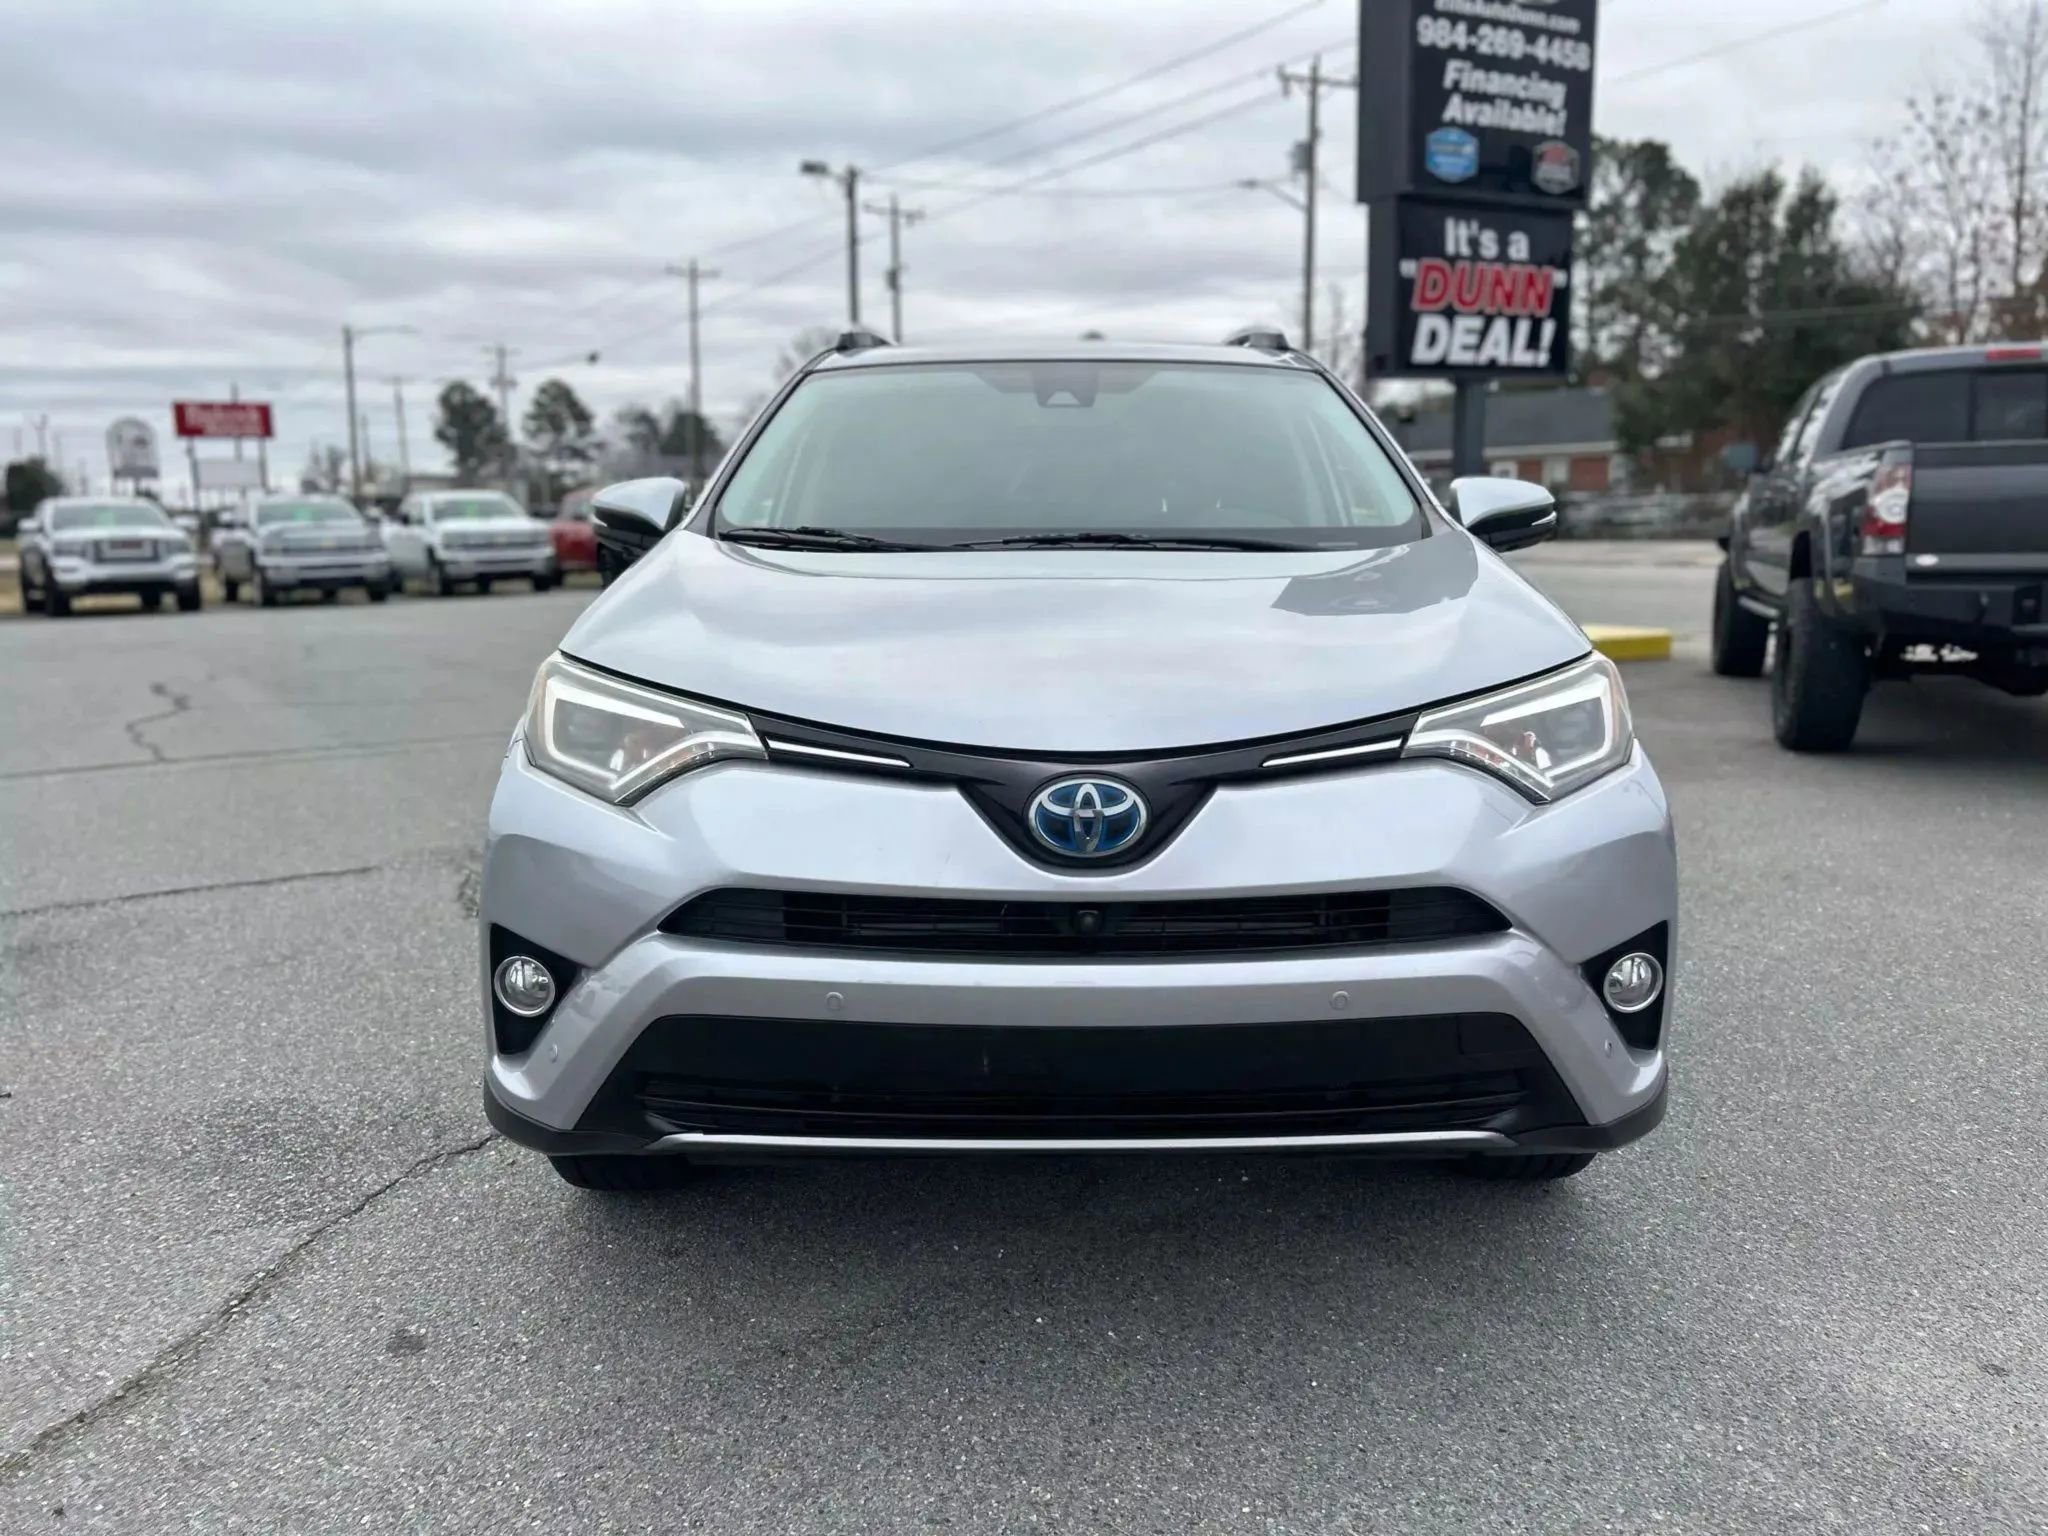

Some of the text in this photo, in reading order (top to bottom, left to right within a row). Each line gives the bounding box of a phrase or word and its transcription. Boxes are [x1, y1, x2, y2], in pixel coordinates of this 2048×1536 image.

[1442, 58, 1567, 110] Financing
[1442, 93, 1567, 136] Available!
[1445, 217, 1530, 260] It's a
[1411, 313, 1556, 367] DEAL!
